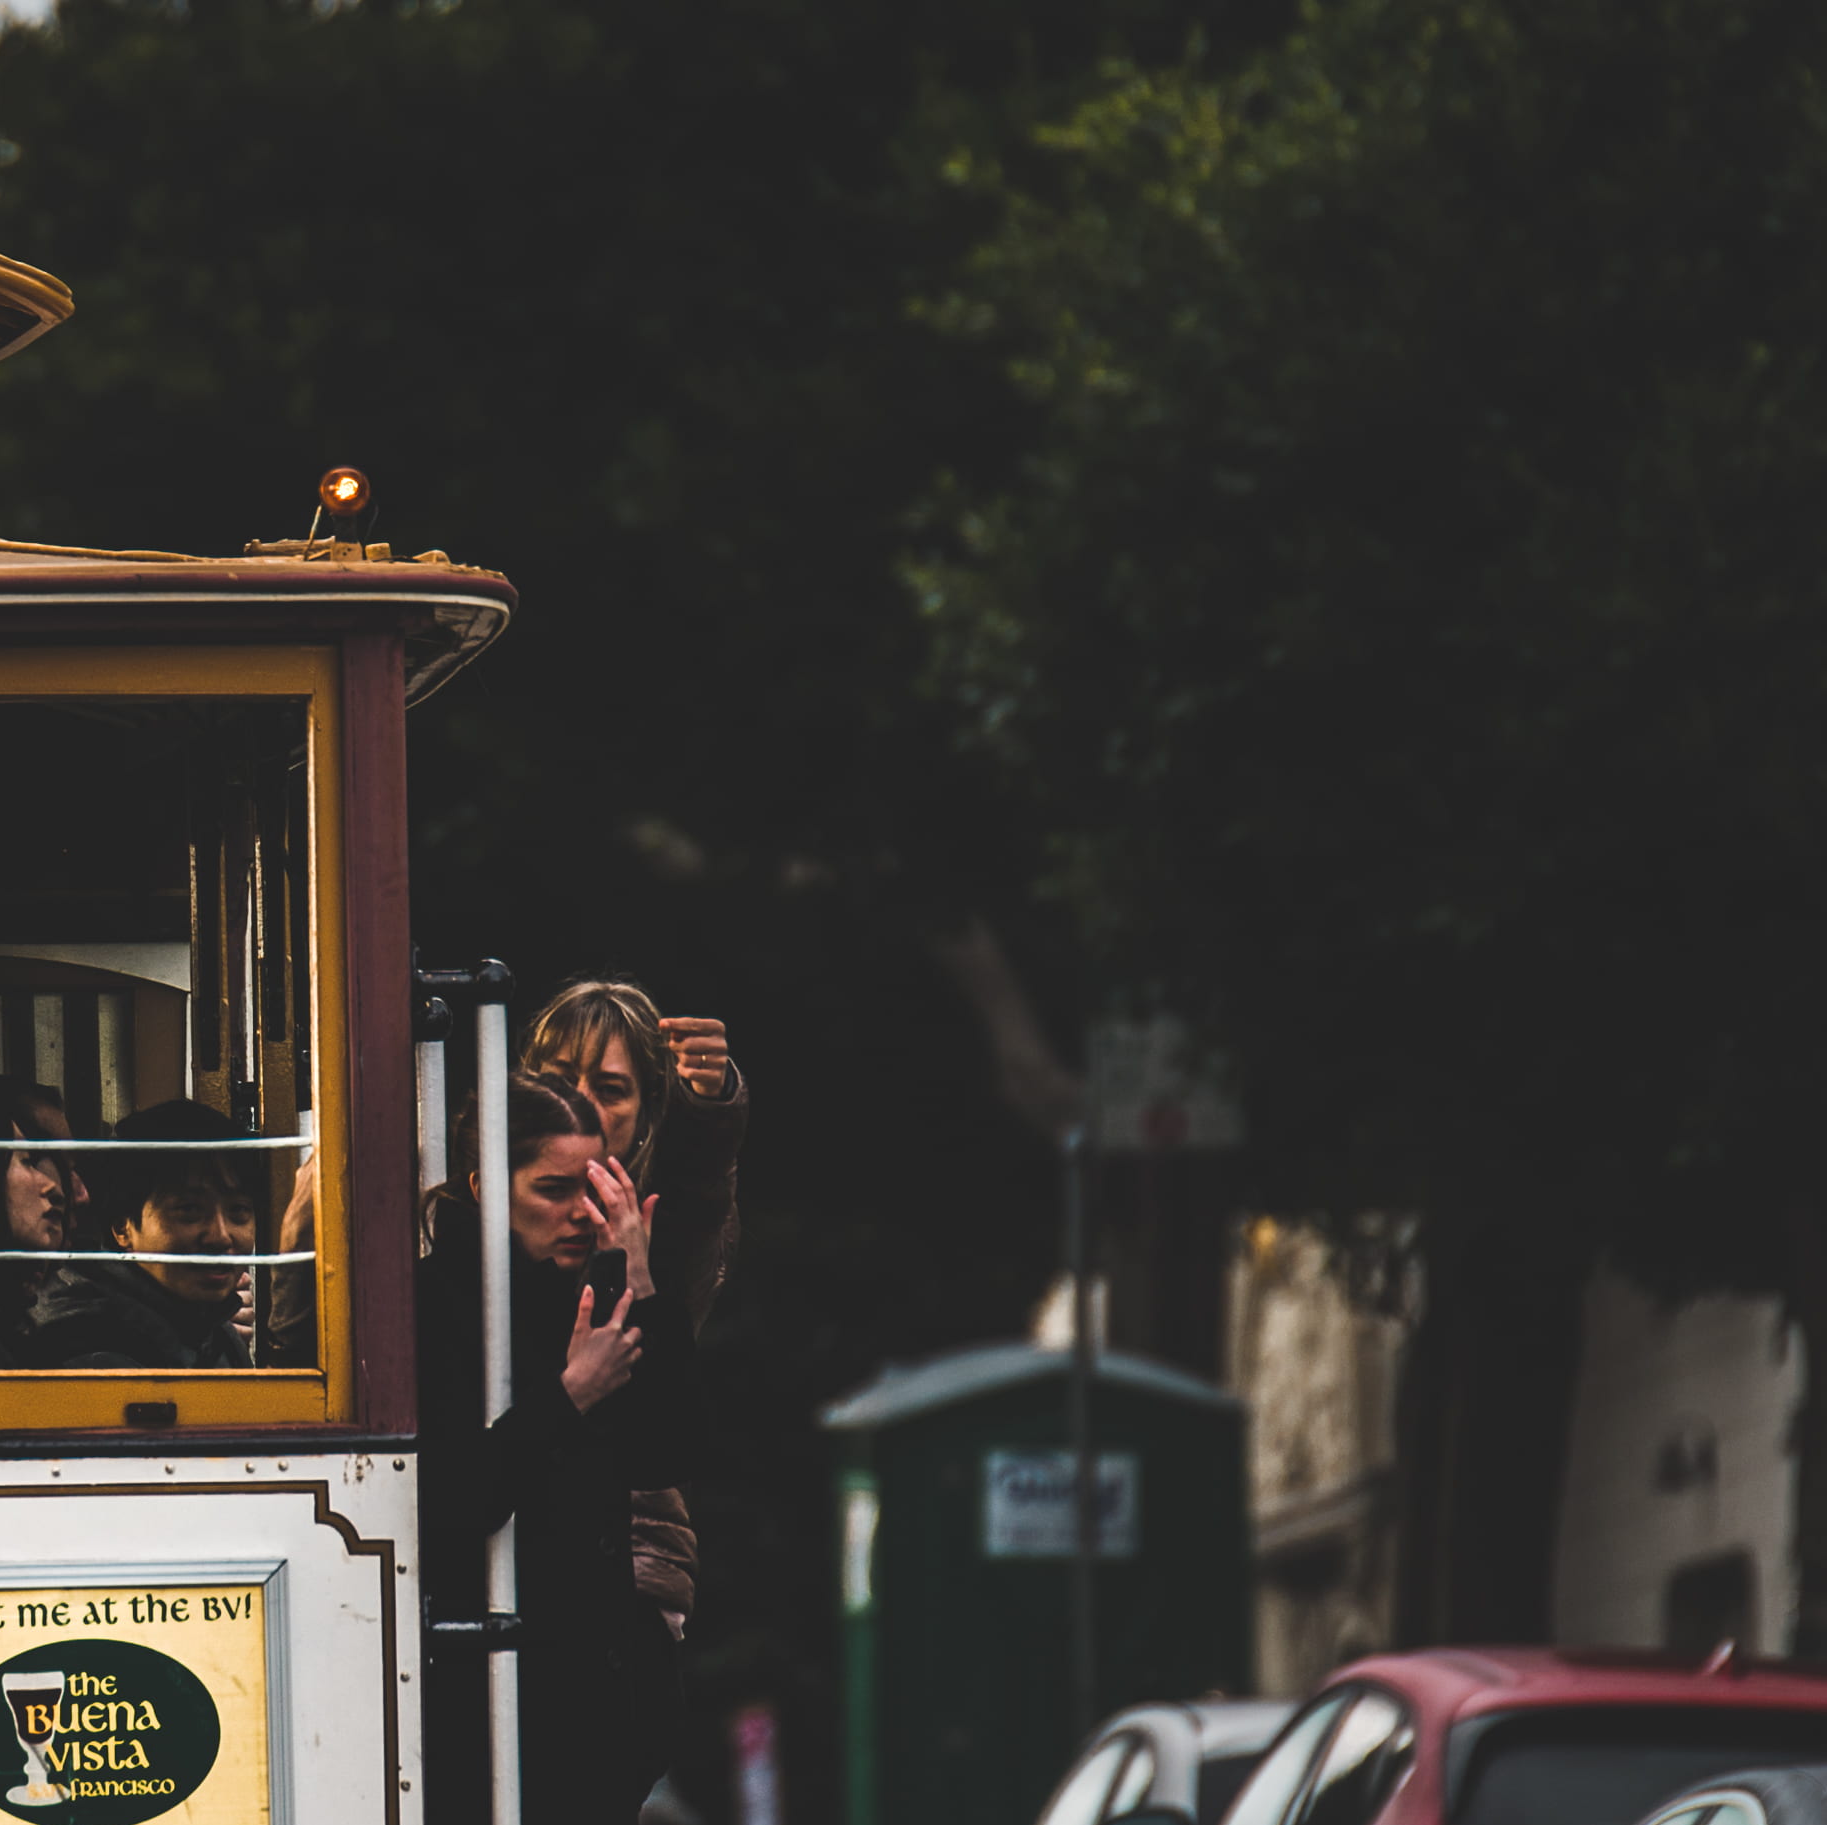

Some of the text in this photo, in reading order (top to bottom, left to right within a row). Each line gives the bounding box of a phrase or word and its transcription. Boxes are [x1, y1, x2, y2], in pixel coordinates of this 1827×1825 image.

[18, 1602, 70, 1627] me
[83, 1597, 118, 1625] at
[128, 1593, 190, 1623] the
[203, 1593, 252, 1621] BV!
[67, 1672, 117, 1697] the
